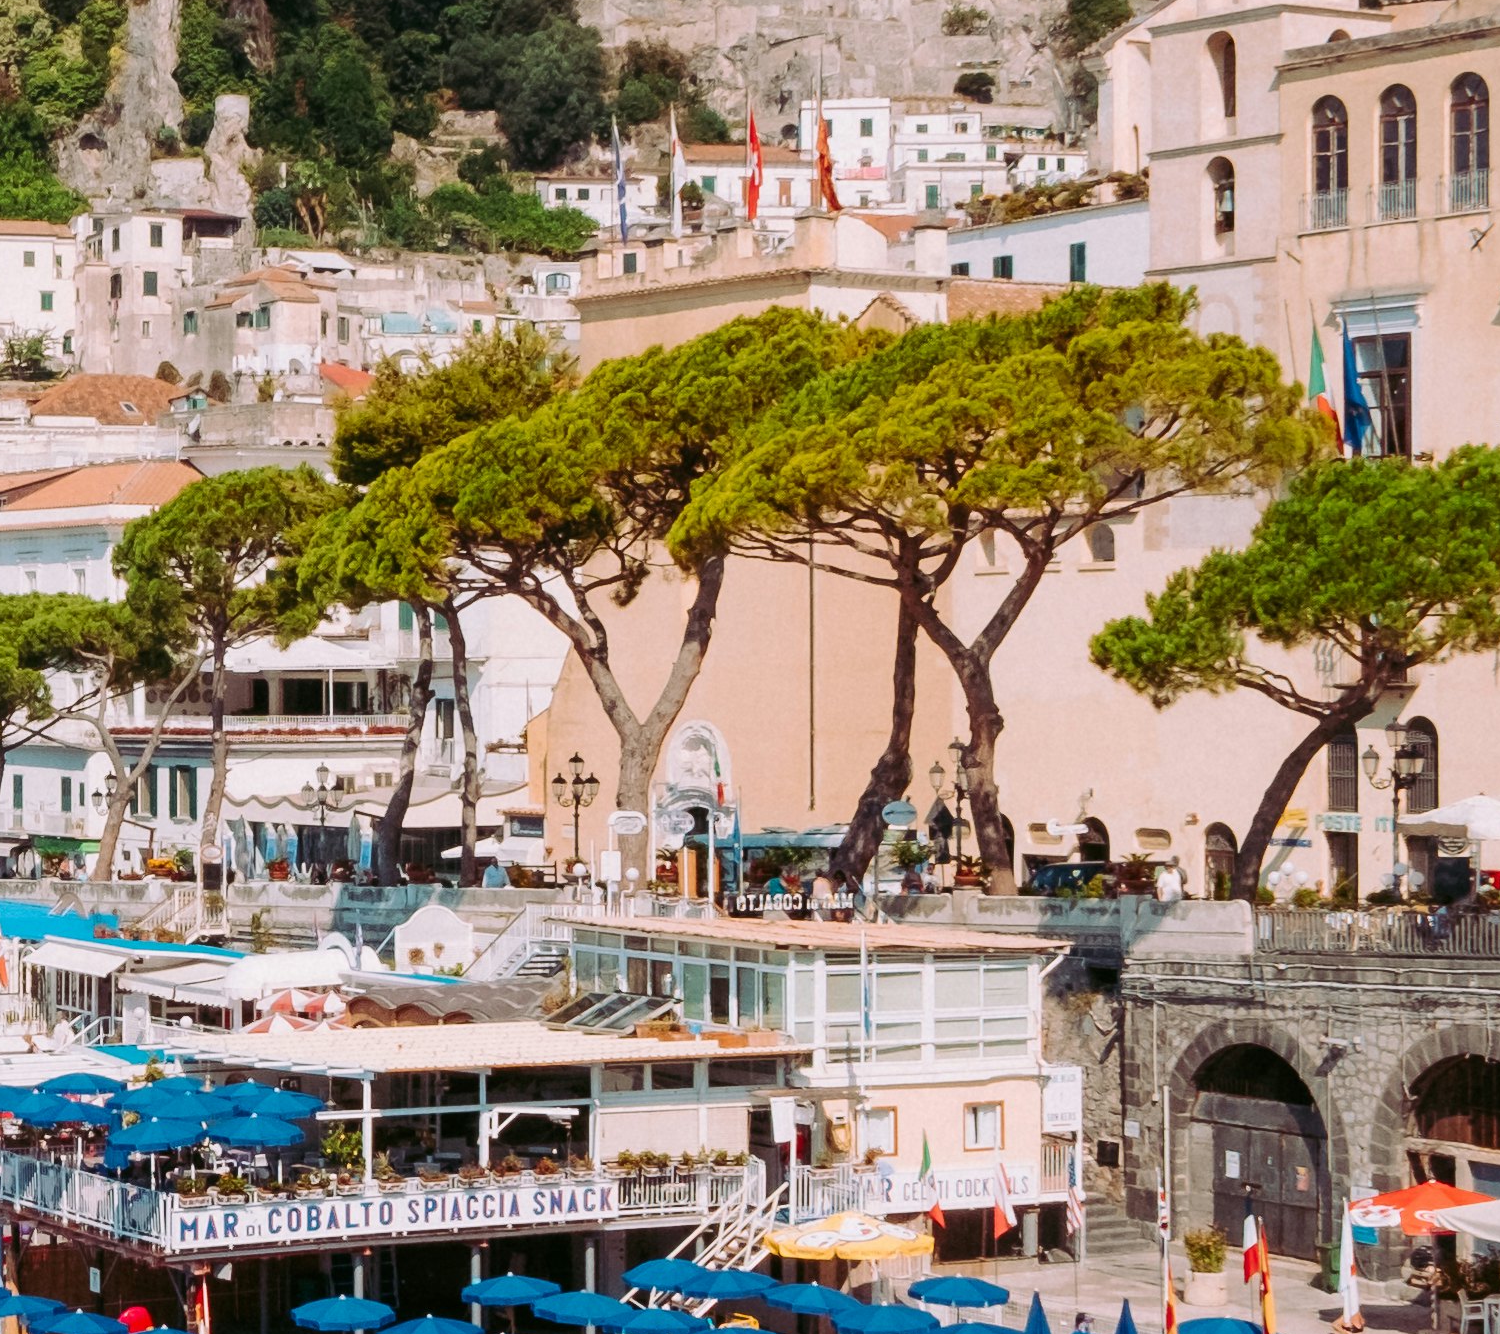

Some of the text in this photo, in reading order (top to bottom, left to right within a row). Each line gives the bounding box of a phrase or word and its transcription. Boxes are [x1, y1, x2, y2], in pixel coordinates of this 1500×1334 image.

[1315, 814, 1362, 832] POSTE
[903, 1179, 949, 1202] GELTI
[179, 1211, 238, 1242] MAR
[268, 1199, 395, 1235] COBALTO
[407, 1191, 520, 1225] SPIAGGIA
[532, 1185, 615, 1216] SNACK
